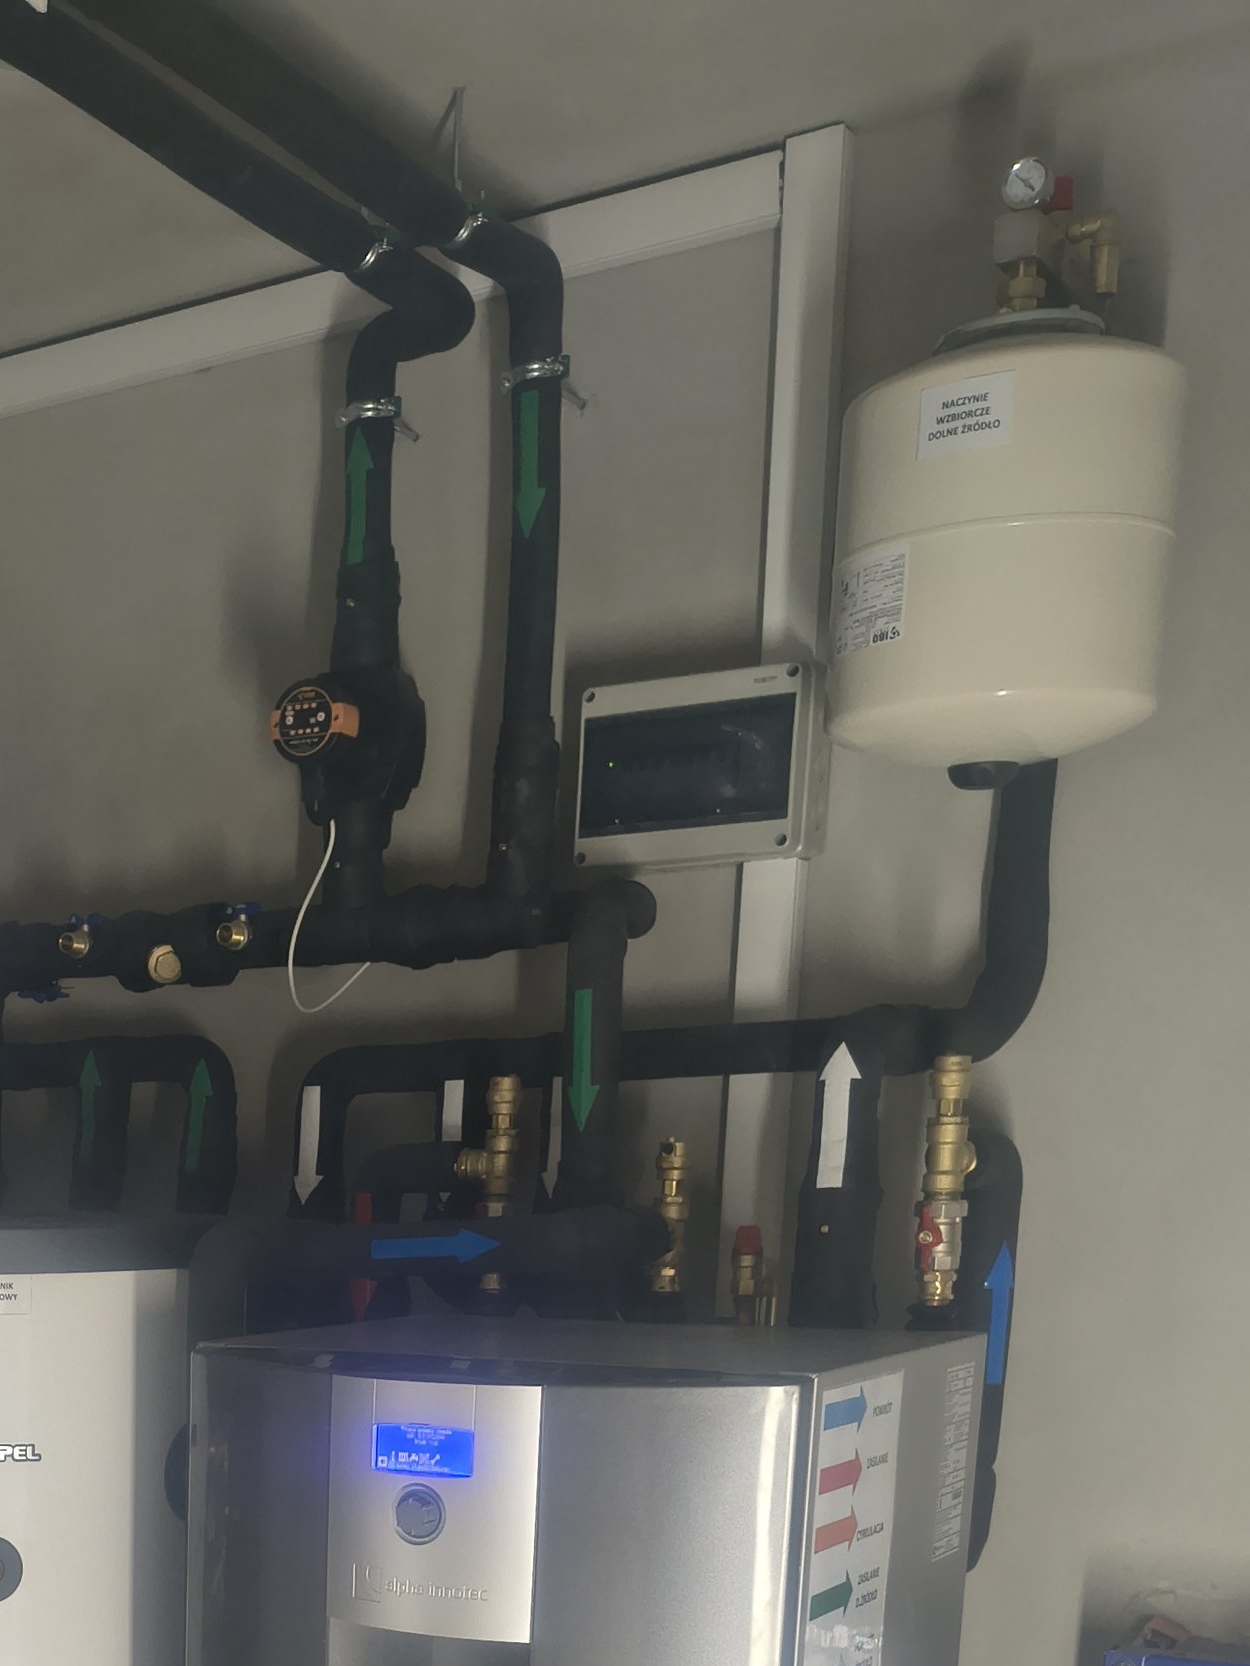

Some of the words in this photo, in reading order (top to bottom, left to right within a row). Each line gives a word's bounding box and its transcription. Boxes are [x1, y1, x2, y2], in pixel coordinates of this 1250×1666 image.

[941, 392, 989, 410] NACZYNIE
[936, 406, 991, 425] WZBIORCZE
[928, 427, 959, 441] DOLNE
[961, 419, 1001, 434] ŹRÓDŁO
[384, 1577, 423, 1596] alpha
[428, 1581, 489, 1601] innotec
